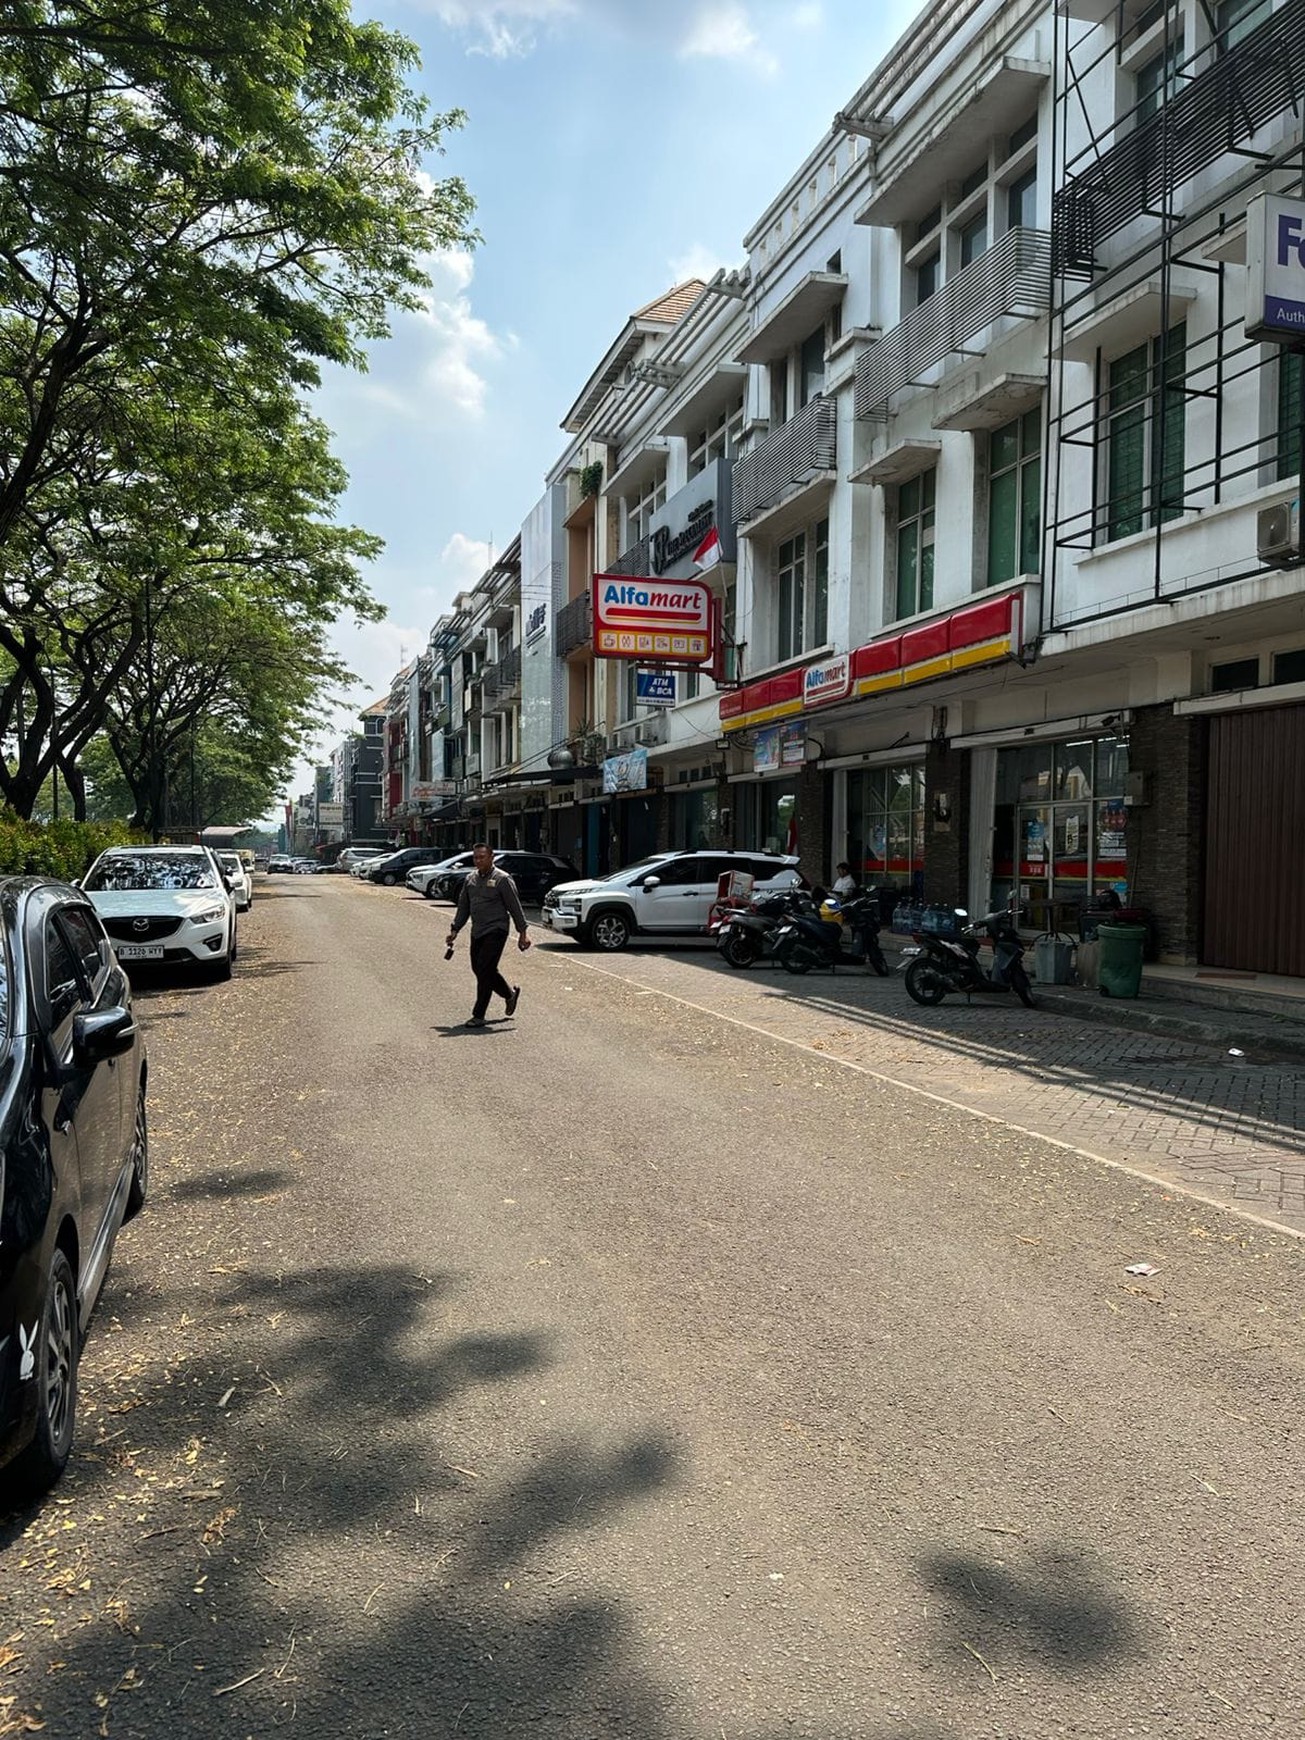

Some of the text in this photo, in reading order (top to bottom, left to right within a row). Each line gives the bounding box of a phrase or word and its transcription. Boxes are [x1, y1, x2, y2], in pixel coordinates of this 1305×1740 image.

[604, 585, 701, 609] Alfamart
[652, 678, 669, 686] ATM
[806, 661, 845, 688] Alfamart
[656, 687, 672, 695] BCA
